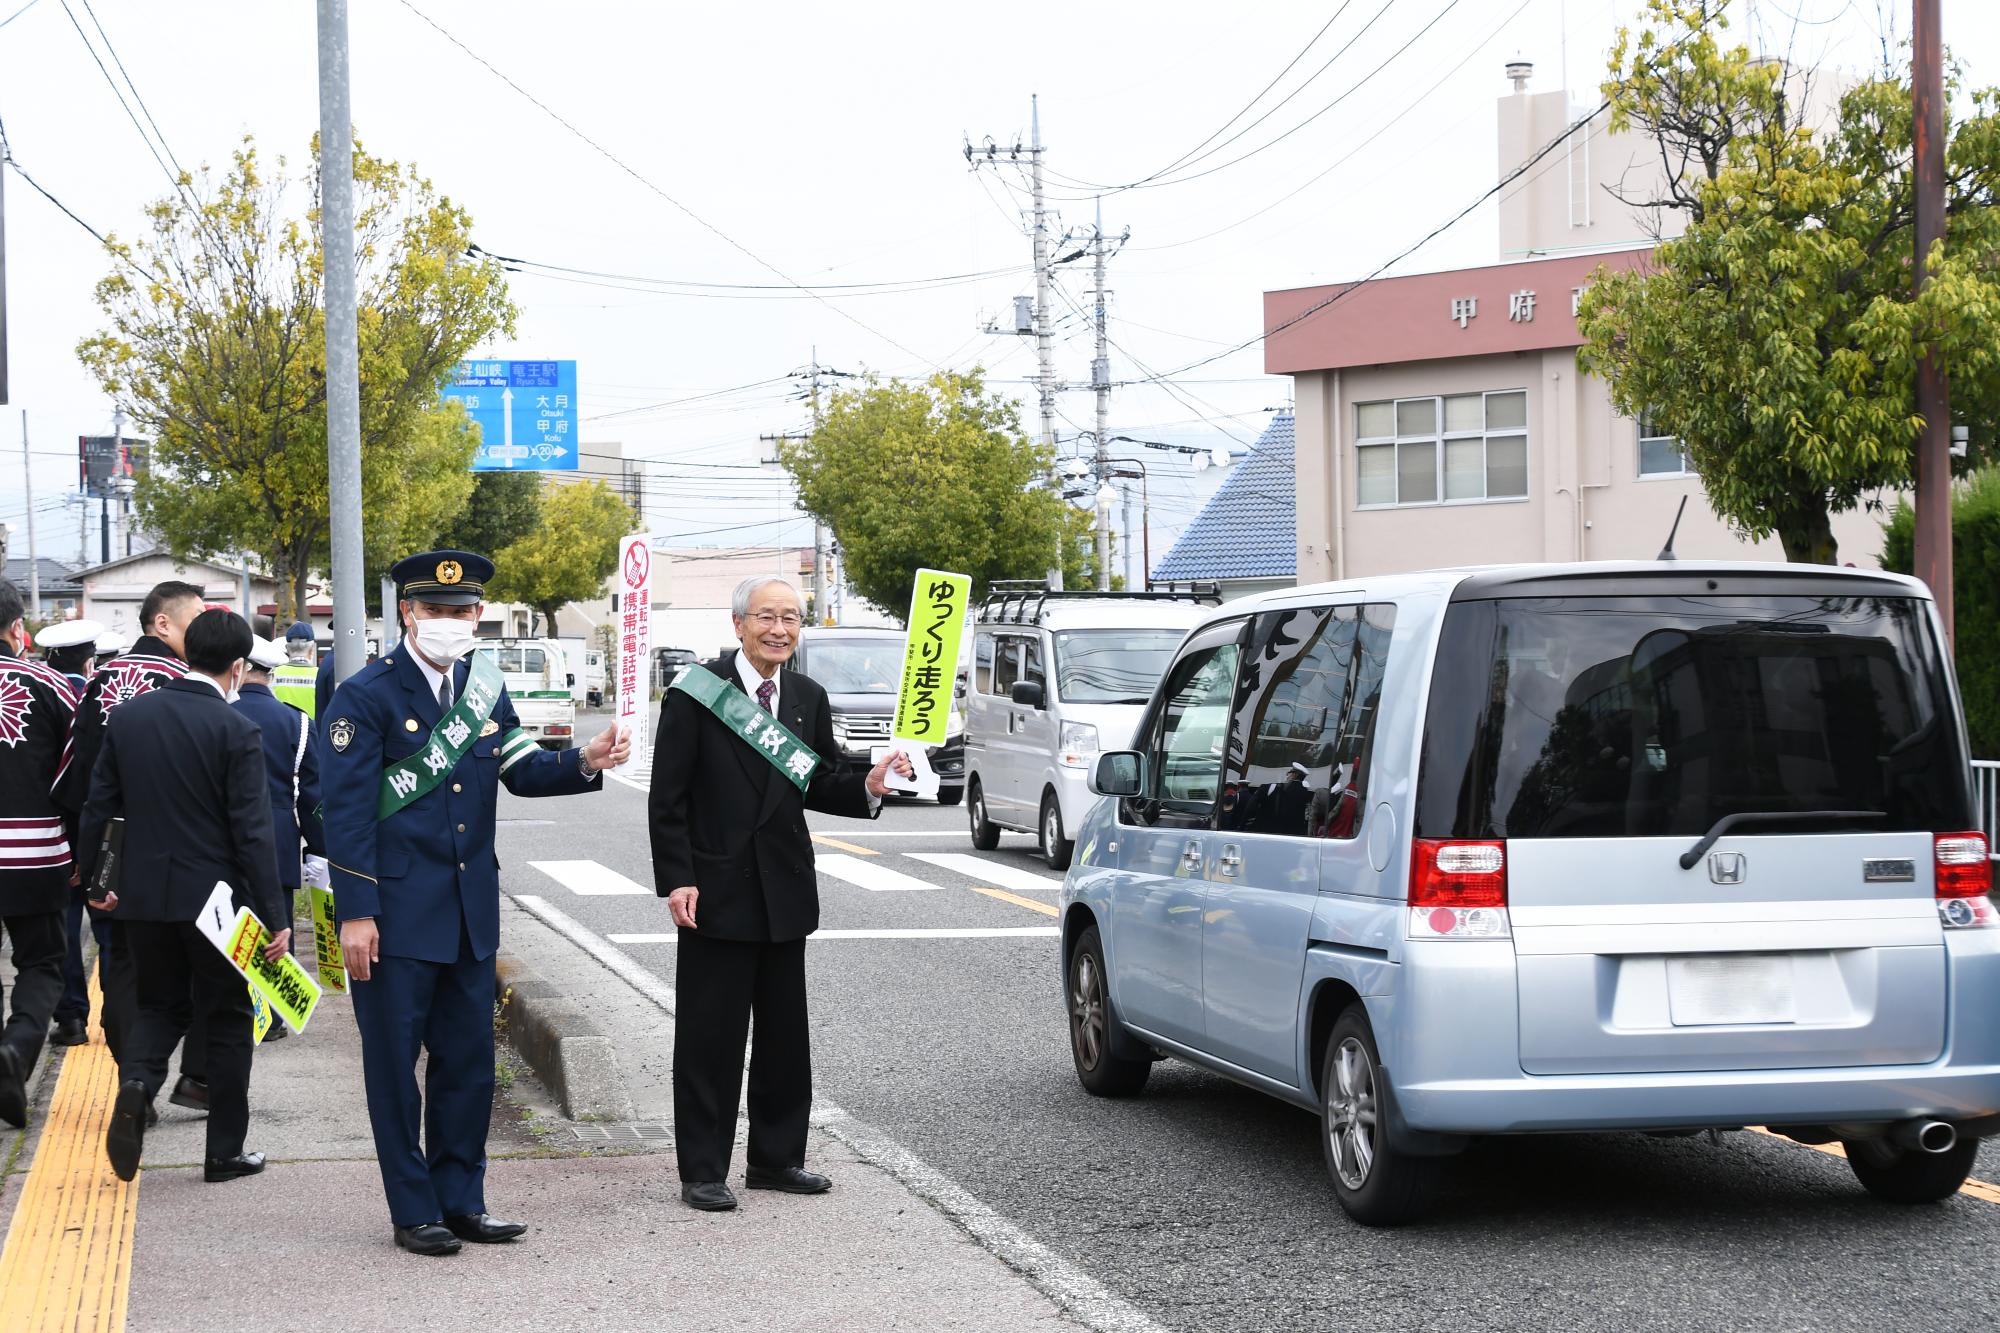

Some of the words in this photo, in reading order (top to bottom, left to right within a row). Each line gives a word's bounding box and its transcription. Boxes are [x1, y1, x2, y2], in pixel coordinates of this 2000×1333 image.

[512, 363, 556, 377] 竜王駅
[516, 377, 535, 386] Ryuo
[536, 394, 569, 409] 大月
[541, 409, 564, 417] Otsuki
[537, 420, 569, 434] 甲府
[544, 434, 562, 442] Kofu
[540, 446, 550, 454] 20
[638, 589, 648, 657] 運転中の
[621, 591, 638, 717] 携帯電話禁止
[911, 580, 955, 736] ゆっくり走ろう
[388, 688, 488, 799] 交通安全
[758, 724, 816, 780] 交通
